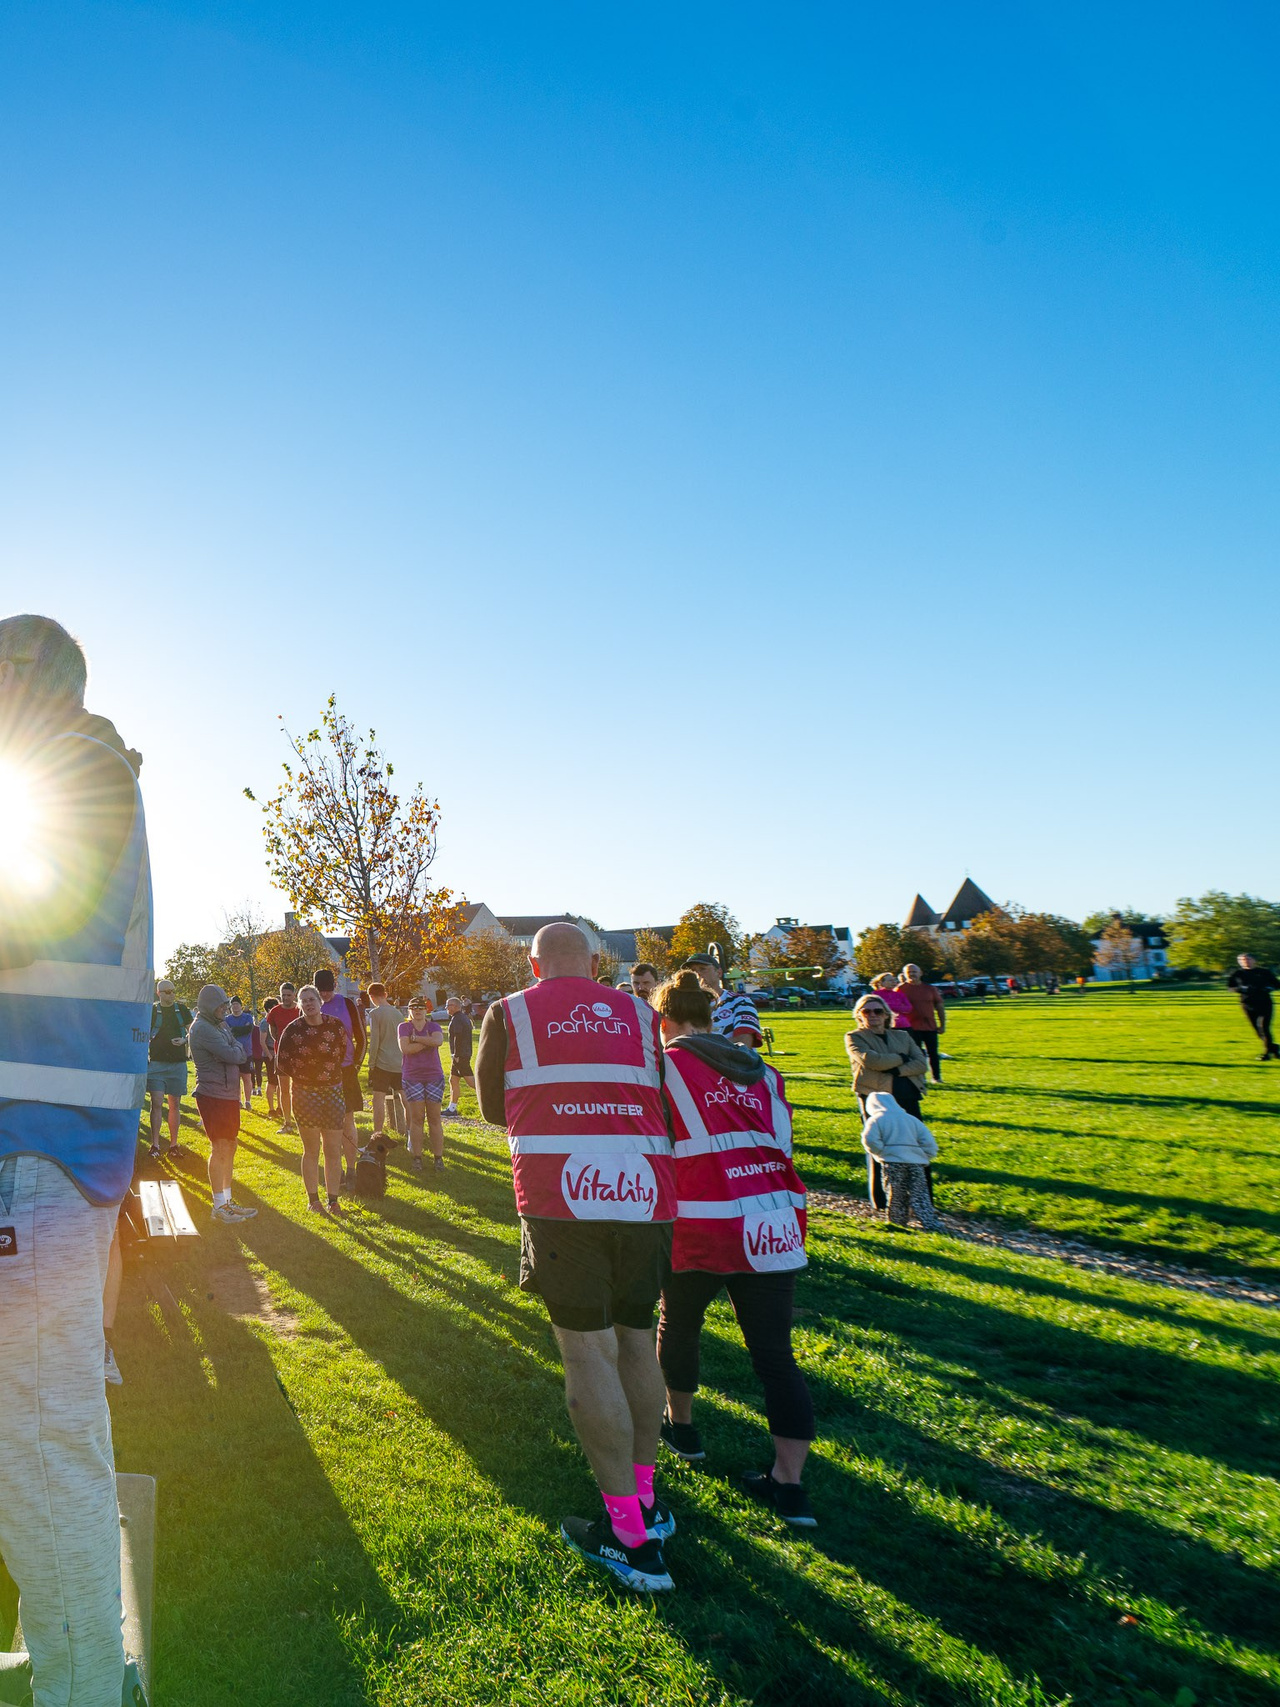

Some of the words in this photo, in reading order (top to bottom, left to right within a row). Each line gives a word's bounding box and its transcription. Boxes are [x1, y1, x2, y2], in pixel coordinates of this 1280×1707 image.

[548, 1009, 630, 1038] parkrun
[552, 1103, 644, 1117] VOLUNTEER
[565, 1164, 655, 1215] Vitality
[600, 1544, 629, 1564] HOKA
